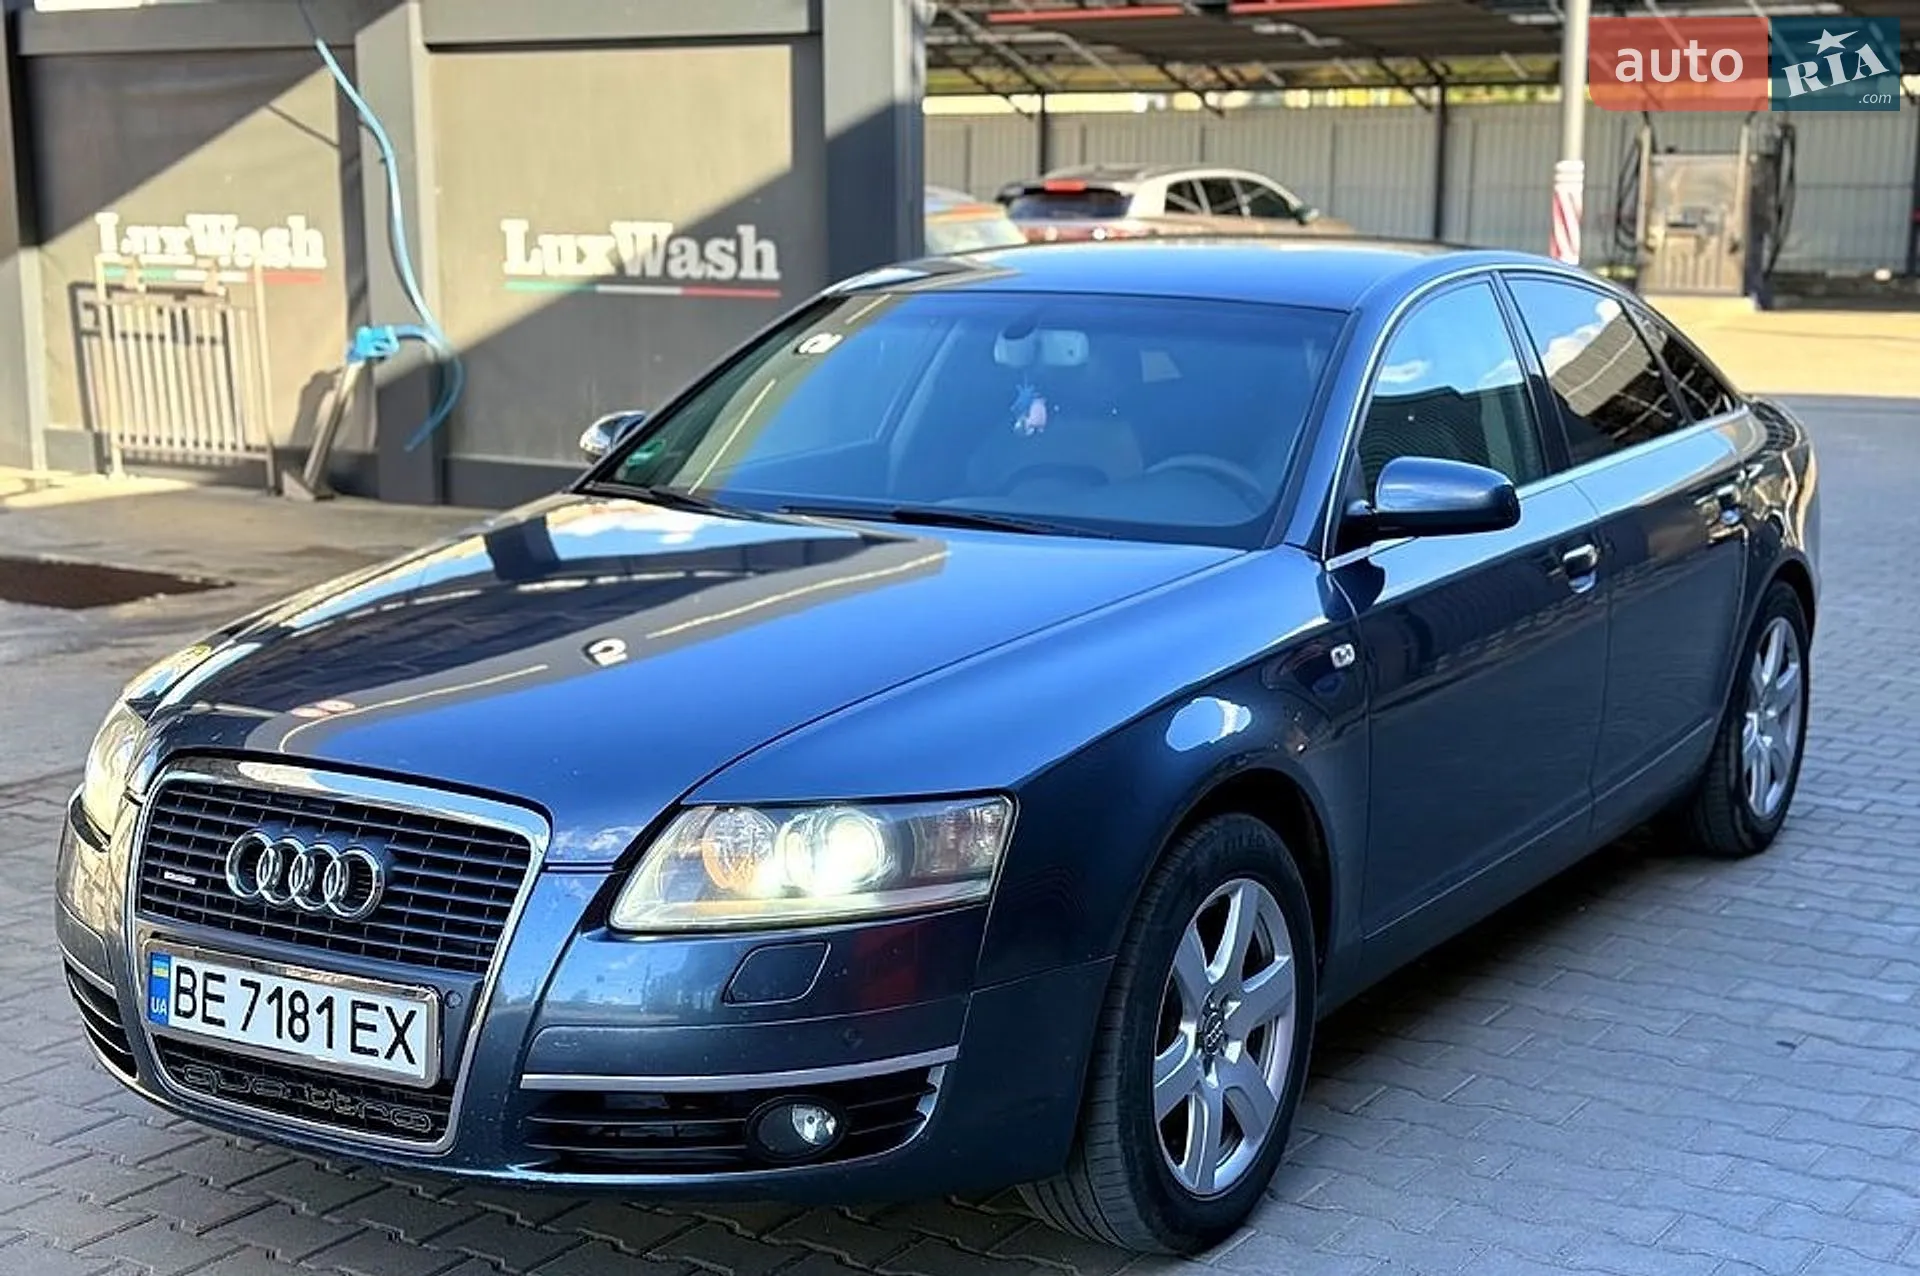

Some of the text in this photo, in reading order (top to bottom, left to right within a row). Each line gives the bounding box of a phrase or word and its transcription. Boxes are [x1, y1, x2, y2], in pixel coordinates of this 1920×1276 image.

[500, 218, 780, 280] LuxWash
[151, 998, 168, 1016] UA
[174, 965, 417, 1065] BE 7181 EX
